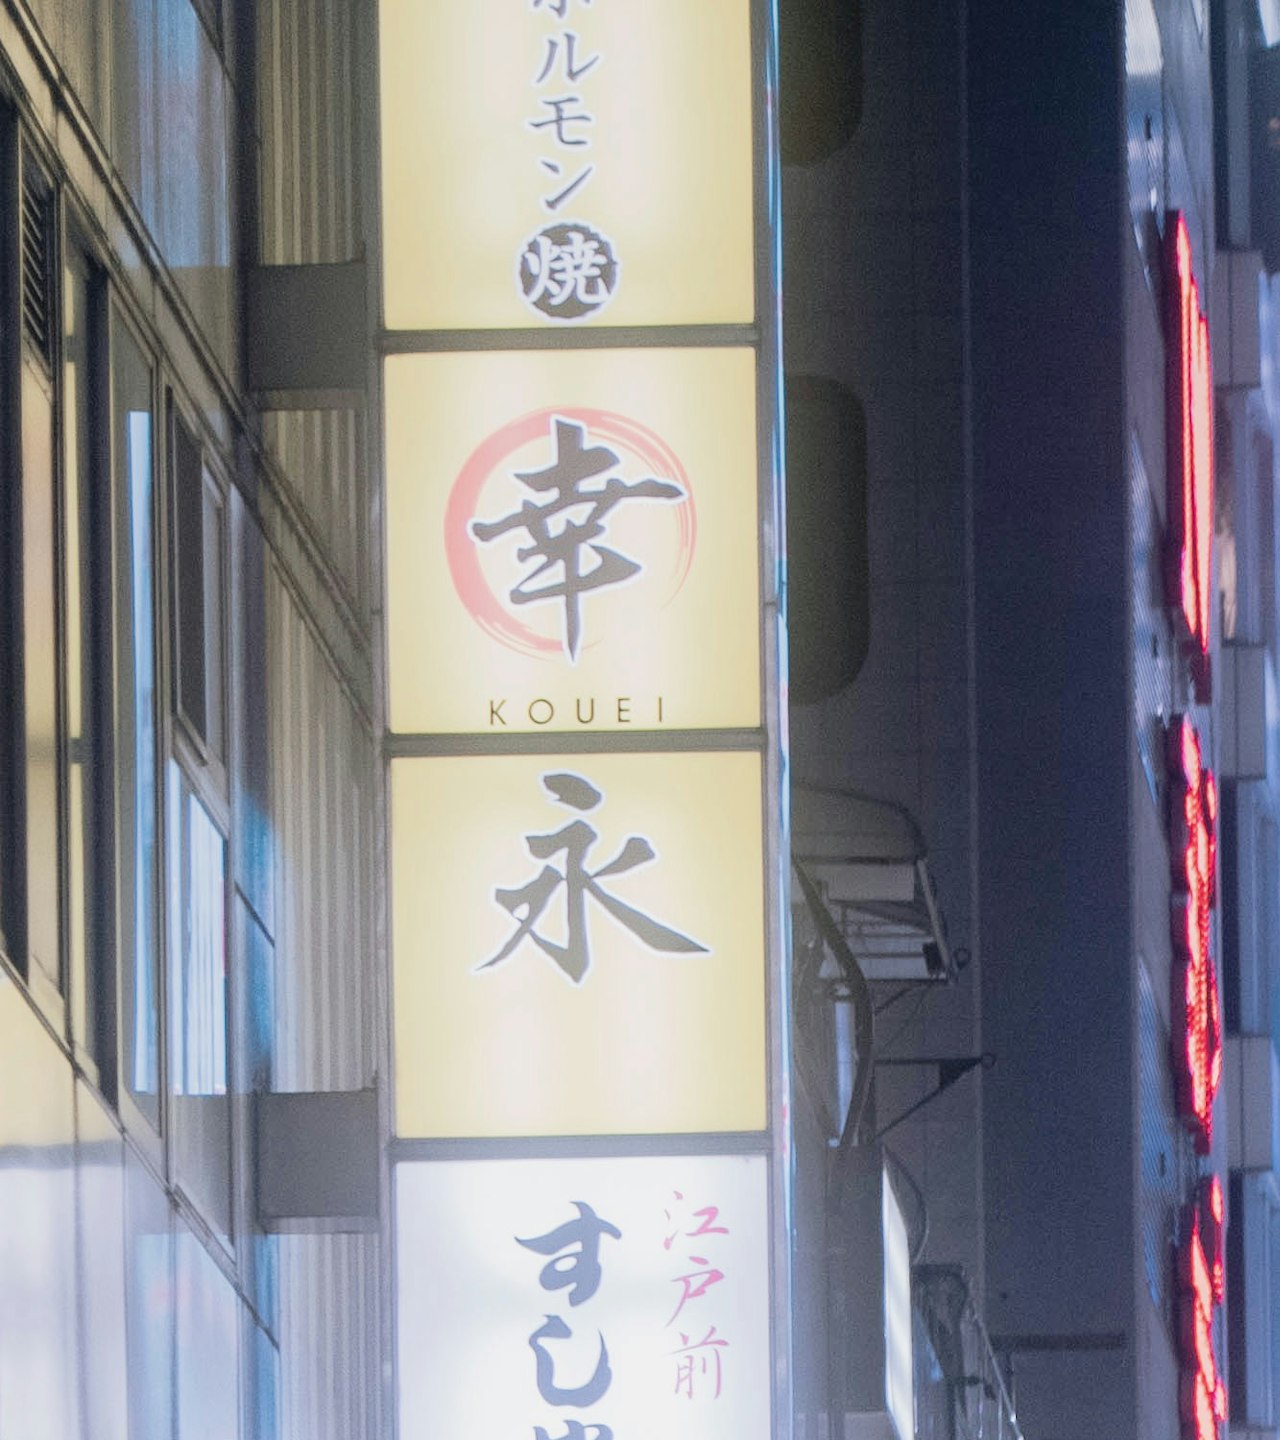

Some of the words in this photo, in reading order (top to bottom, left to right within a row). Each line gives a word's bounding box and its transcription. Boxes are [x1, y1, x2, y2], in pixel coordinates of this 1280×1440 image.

[470, 417, 687, 664] 幸
[489, 698, 664, 725] KOUEI
[472, 771, 715, 986] 永
[662, 1190, 730, 1402] 江戸前
